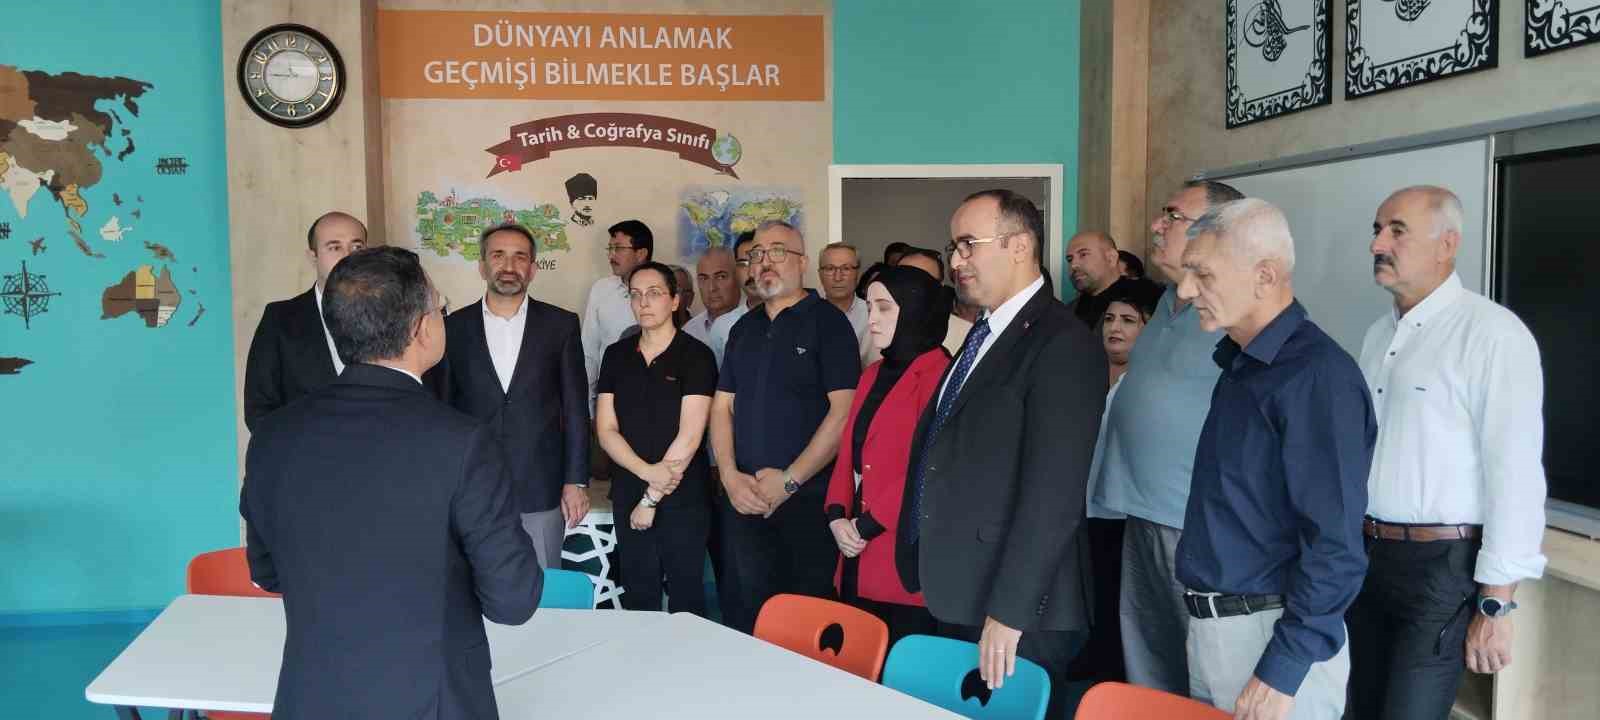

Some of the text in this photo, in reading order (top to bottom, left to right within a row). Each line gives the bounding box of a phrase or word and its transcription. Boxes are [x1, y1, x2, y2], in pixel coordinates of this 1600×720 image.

[474, 20, 733, 49] DÜNYAYI ANLAMAK
[424, 57, 781, 92] GEÇMİŞİ BİLMEKLE BAŞLAR
[517, 122, 710, 150] Tarih & Coğrafya Sınıfı
